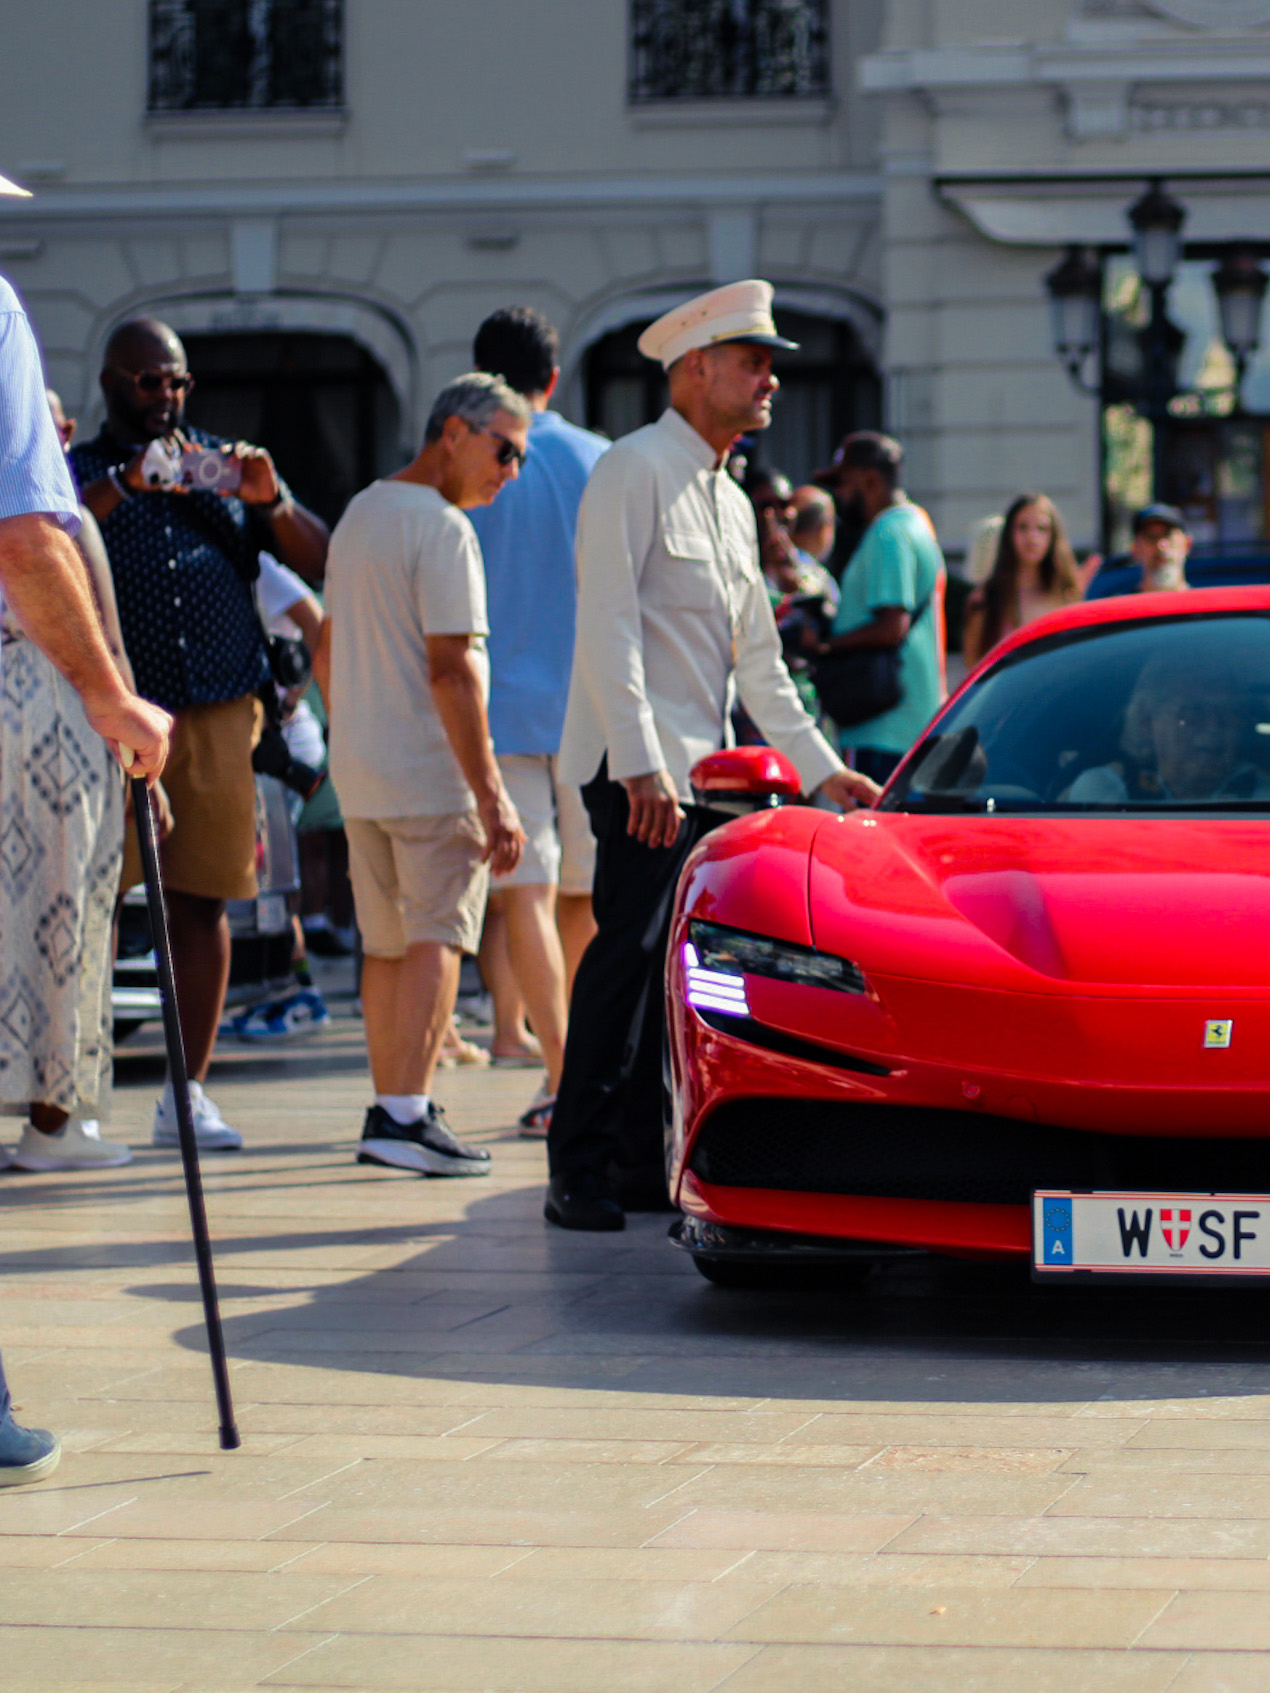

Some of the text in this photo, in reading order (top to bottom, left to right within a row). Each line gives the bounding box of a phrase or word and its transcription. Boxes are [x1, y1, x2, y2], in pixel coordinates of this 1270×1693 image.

[1051, 1240, 1065, 1255] A
[1117, 1207, 1153, 1258] W
[1198, 1209, 1260, 1260] SF
